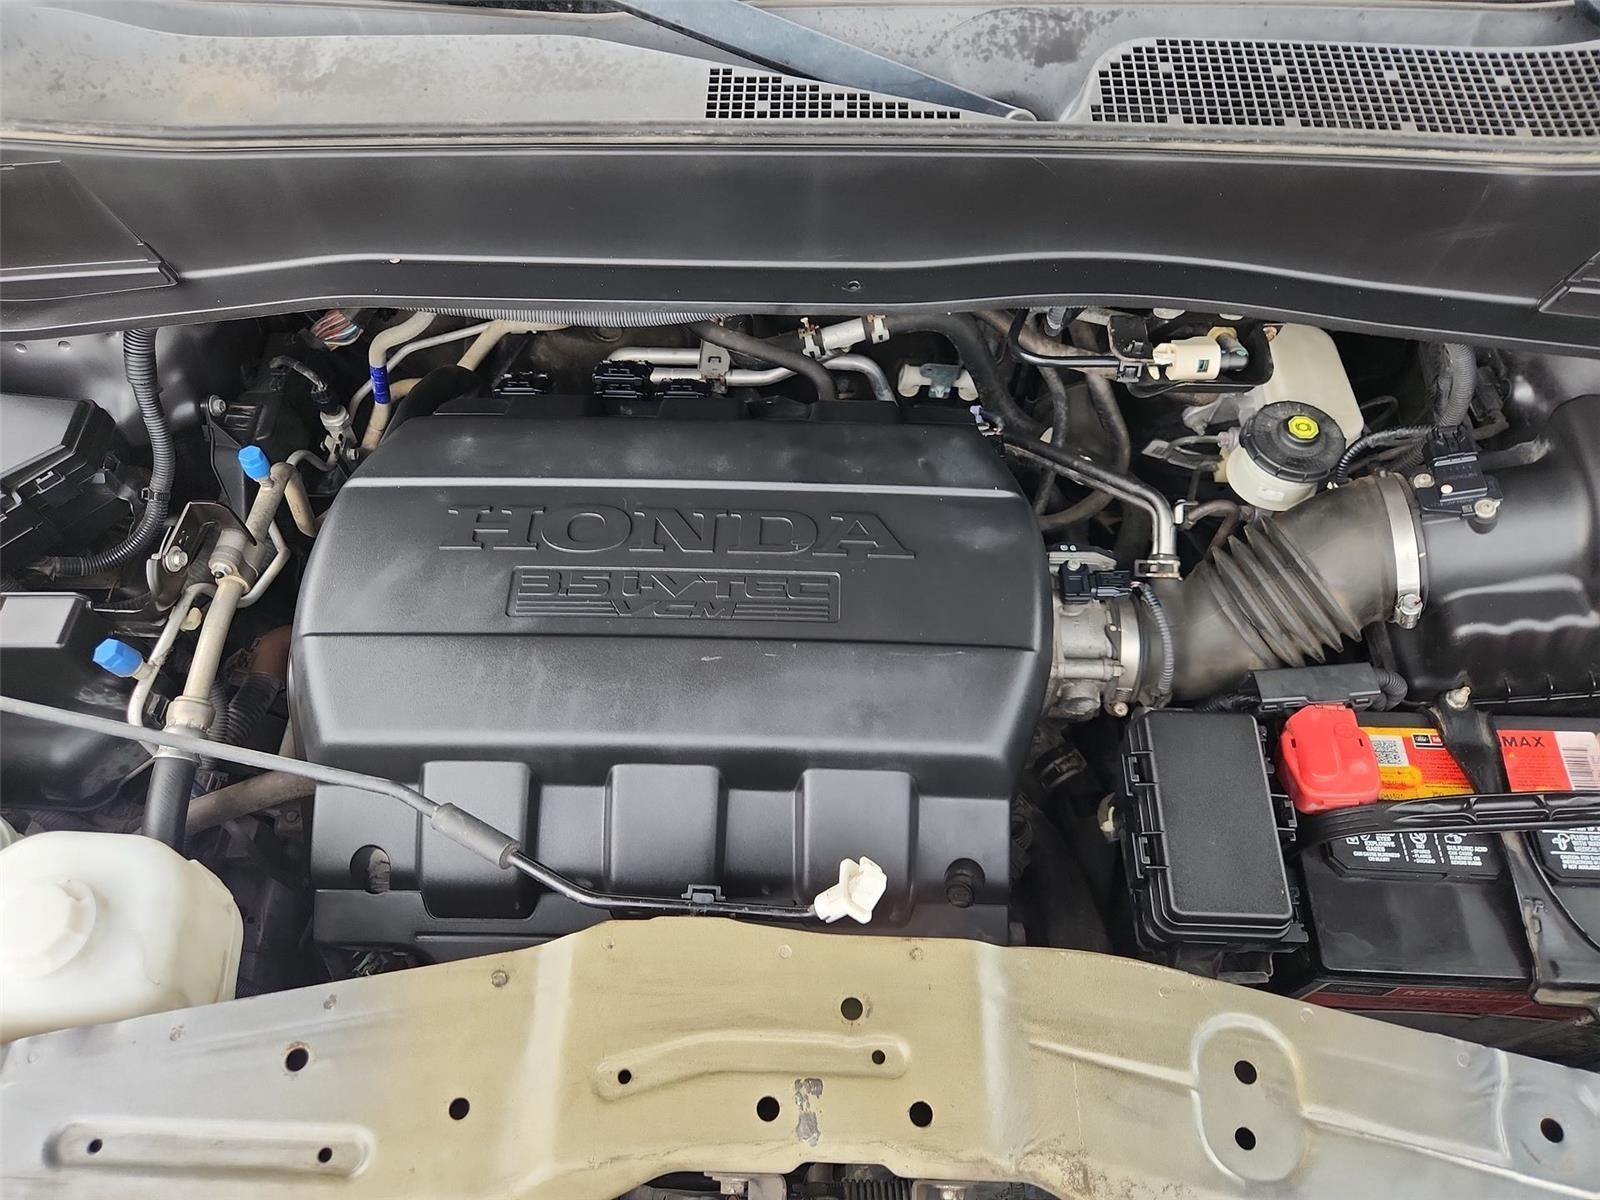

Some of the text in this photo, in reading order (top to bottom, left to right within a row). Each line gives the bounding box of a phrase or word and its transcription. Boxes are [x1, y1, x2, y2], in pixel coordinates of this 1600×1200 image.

[439, 505, 915, 559] HONDA
[517, 571, 612, 596] 3.5
[1501, 736, 1544, 748] MAX
